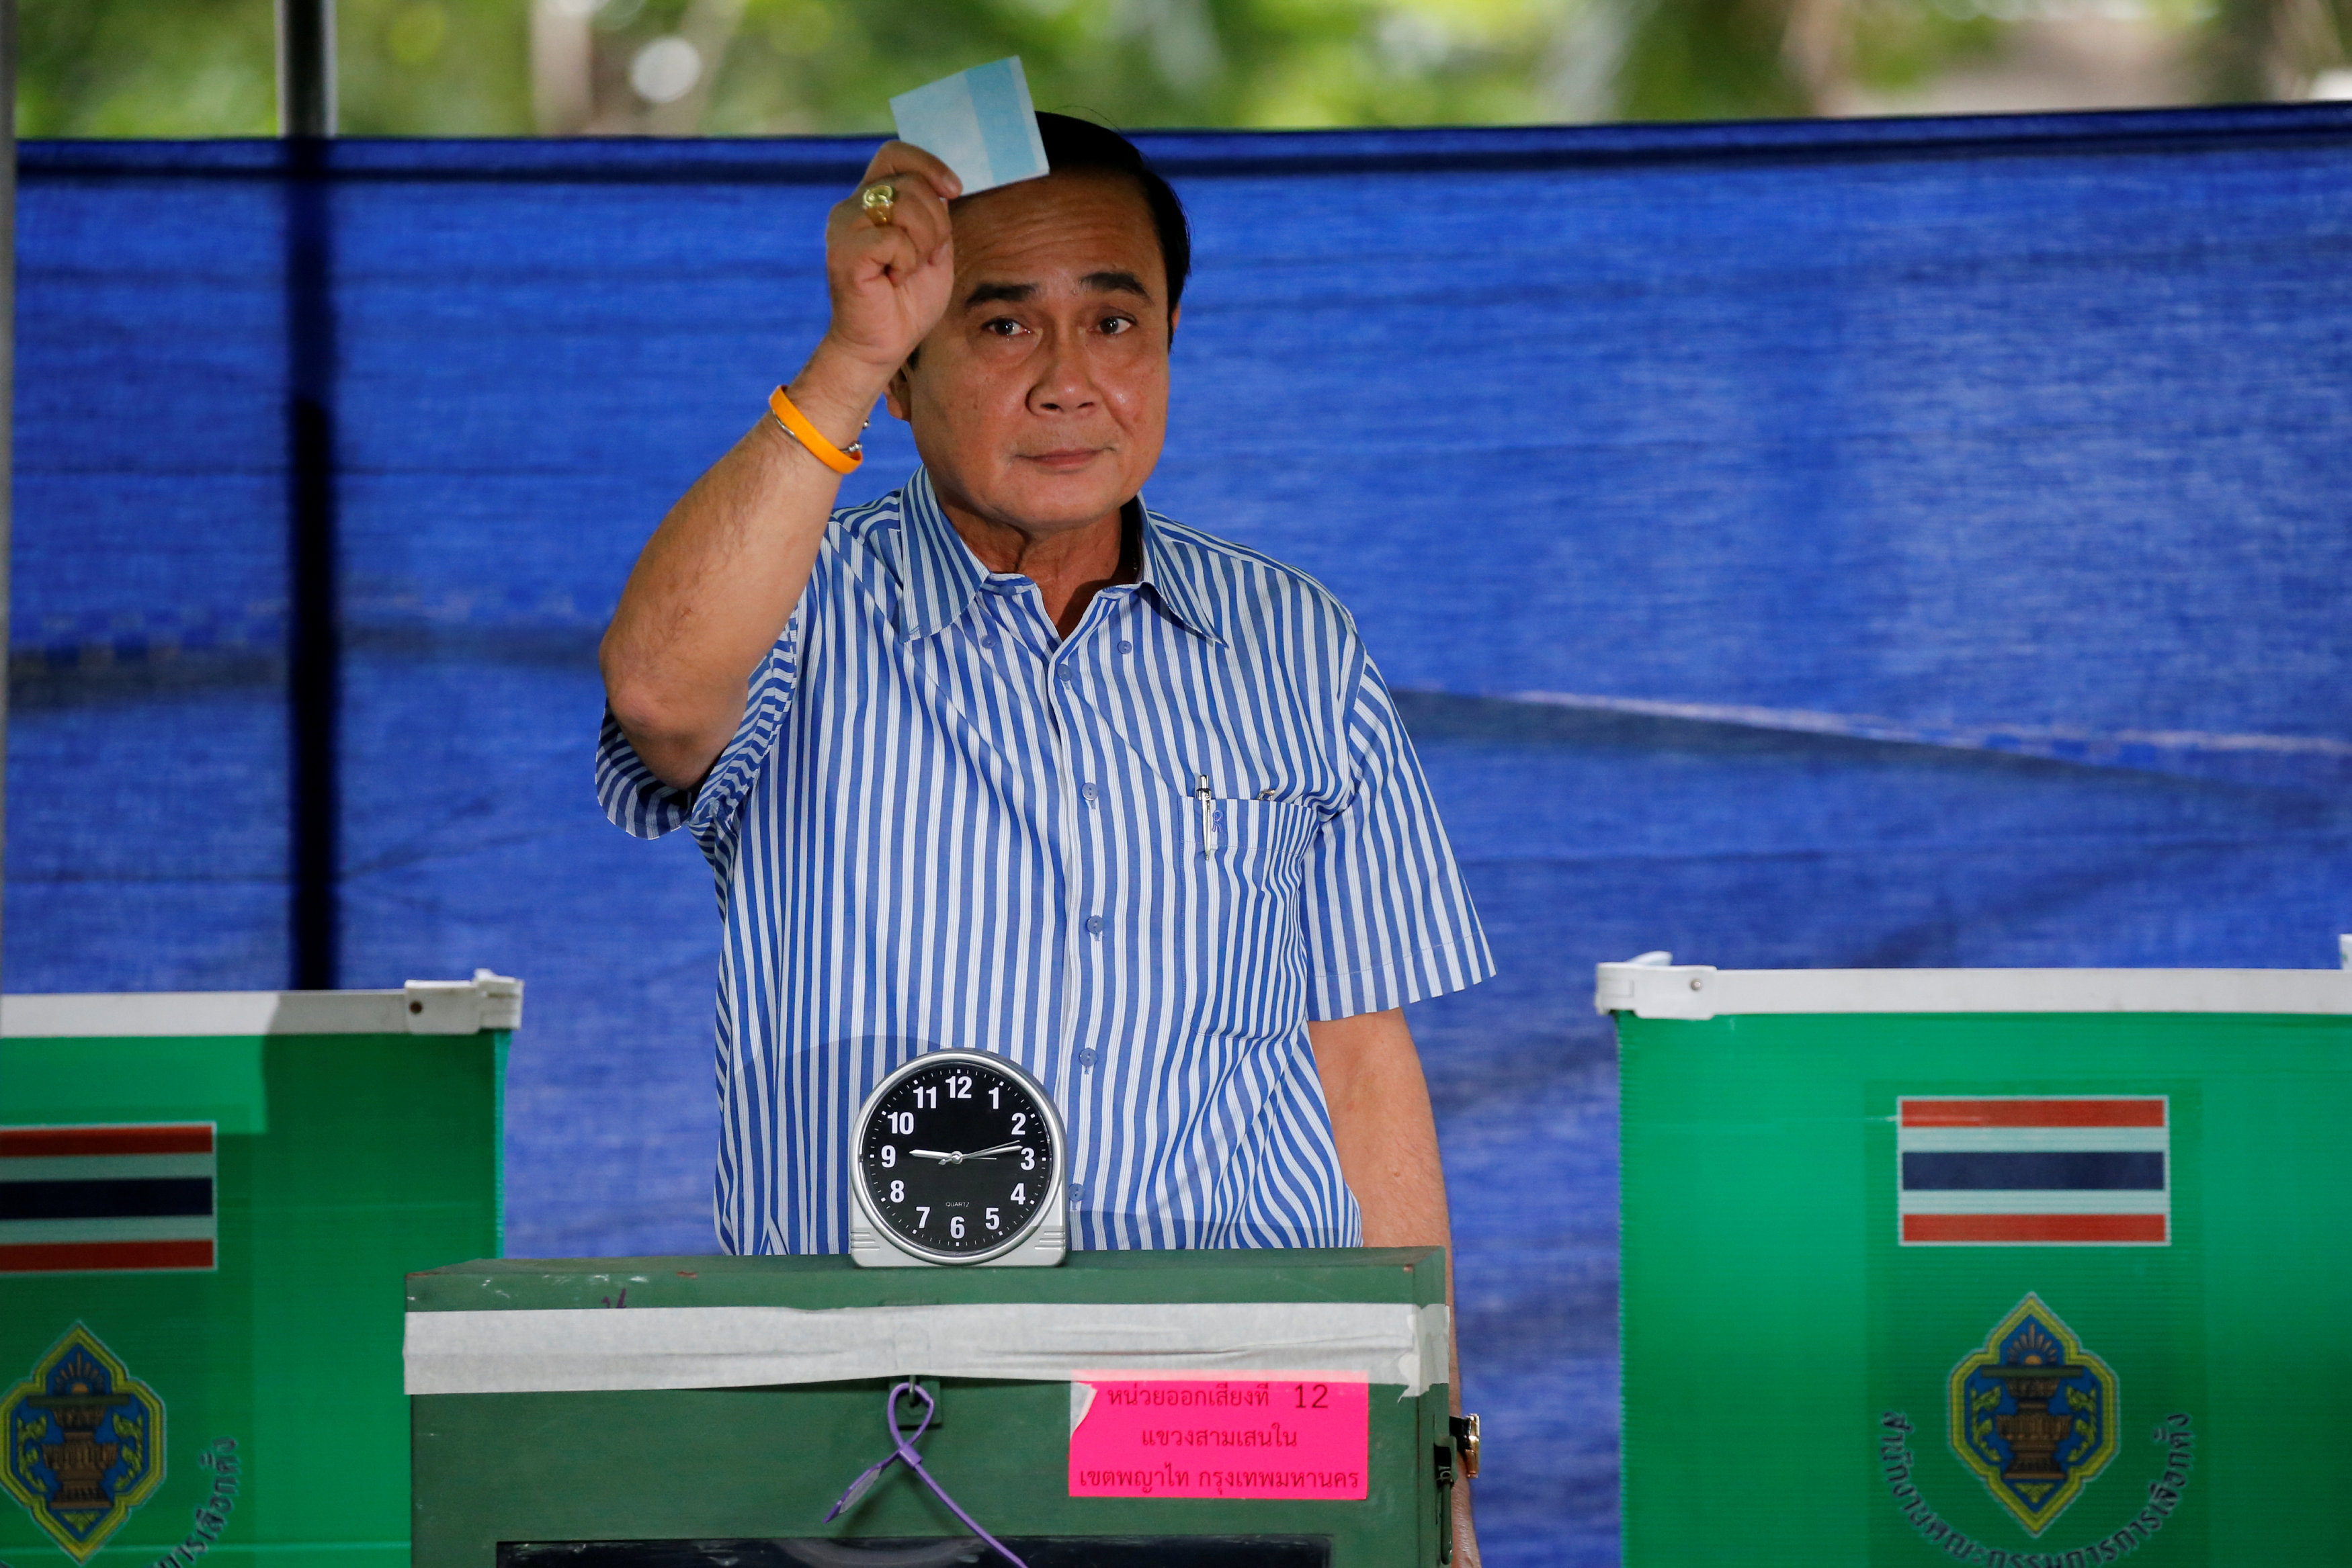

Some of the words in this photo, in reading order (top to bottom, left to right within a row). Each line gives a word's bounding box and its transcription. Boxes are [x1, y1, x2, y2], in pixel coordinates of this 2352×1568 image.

[913, 1086, 937, 1108] 11
[946, 1076, 972, 1098] 12
[989, 1087, 999, 1109] 1
[888, 1112, 915, 1134] 10
[1011, 1113, 1026, 1135] 2
[881, 1145, 896, 1168] 9
[1020, 1147, 1036, 1170] 3
[890, 1180, 905, 1203] 8
[1010, 1183, 1026, 1205] 4
[916, 1207, 931, 1229] 7
[950, 1217, 965, 1239] 6
[985, 1208, 1000, 1230] 5
[1296, 1384, 1329, 1409] 12
[1142, 1422, 1297, 1446] แขวงสามเสนใน
[1080, 1463, 1189, 1493] เขตพญาไท
[1199, 1471, 1359, 1495] กรุงเทพมหานคร
